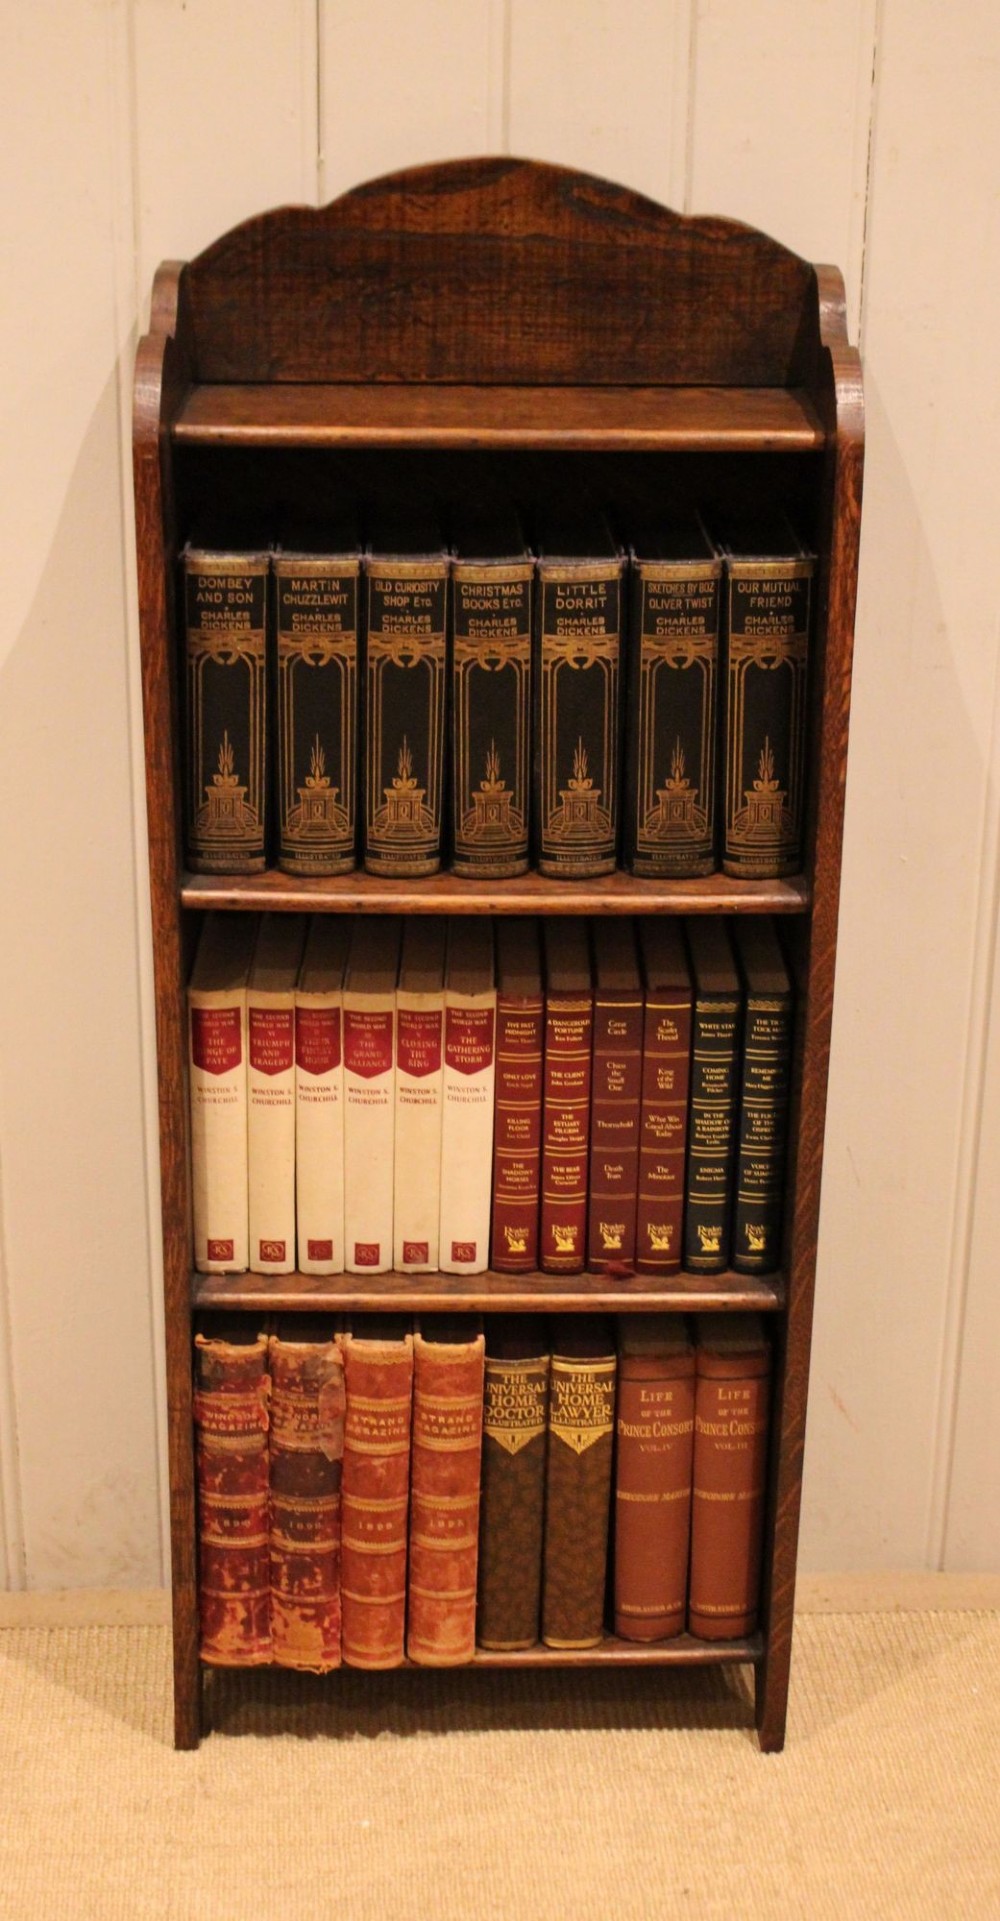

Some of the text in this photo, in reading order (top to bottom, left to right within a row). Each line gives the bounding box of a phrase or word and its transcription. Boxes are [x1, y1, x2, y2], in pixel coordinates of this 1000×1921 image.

[198, 576, 253, 589] DOMBEY
[291, 579, 340, 592] MARTIN
[375, 580, 440, 593] OLD CURIOSITY
[647, 580, 715, 594] SKETCHES BY BOZ
[737, 581, 801, 594] OUR MUTUAL
[461, 583, 524, 597] CHRISTMAS
[556, 582, 607, 596] LITTLE
[197, 592, 254, 604] AND SON
[283, 592, 349, 605] CHUZZLEWIT
[383, 594, 410, 608] SHOP
[555, 596, 608, 610] DORRIT
[749, 595, 793, 608] FRIEND
[462, 597, 500, 610] BOOKS
[648, 597, 713, 610] OLIVER TWIST
[201, 611, 250, 621] CHARLES
[292, 612, 341, 623] CHARLES
[382, 614, 431, 625] CHARLES
[556, 616, 605, 626] CHARLES
[656, 616, 706, 626] CHARLES
[744, 615, 795, 626] CHARLES
[201, 621, 251, 631] DICKENS
[468, 617, 518, 627] CHARLES
[292, 622, 342, 633] DICKENS
[382, 624, 432, 634] DICKENS
[468, 627, 518, 637] DICKENS
[556, 625, 606, 636] DICKENS
[656, 625, 706, 636] DICKENS
[744, 625, 796, 636] DICKENS
[662, 1019, 675, 1027] The
[252, 1039, 291, 1048] TRIUMPH
[359, 1040, 376, 1048] THE
[400, 1039, 438, 1048] CLOSING
[460, 1036, 477, 1045] THE
[261, 1049, 280, 1057] AND
[353, 1049, 383, 1058] GRAND
[410, 1049, 427, 1059] THE
[447, 1044, 491, 1054] GATHERING
[206, 1057, 228, 1065] FATE
[253, 1058, 290, 1067] TRAGEDY
[347, 1059, 388, 1068] ALLIANCE
[454, 1055, 483, 1064] STORM
[197, 1085, 231, 1094] WINSTON
[252, 1087, 285, 1097] WINSTON
[299, 1084, 332, 1093] WINSTON
[348, 1086, 381, 1096] WINSTON
[399, 1086, 431, 1095] WINSTON
[447, 1085, 481, 1094] WINSTON
[197, 1095, 238, 1105] CHURCHILL
[252, 1098, 293, 1106] CHURCHILL
[299, 1094, 338, 1103] CHURCHILL
[348, 1096, 388, 1105] CHURCHILL
[399, 1096, 438, 1105] CHURCHILL
[447, 1095, 487, 1104] CHURCHILL
[656, 1165, 669, 1174] The
[502, 1374, 528, 1384] THE
[571, 1373, 596, 1383] THE
[640, 1389, 673, 1403] LIFE
[718, 1387, 751, 1401] LIFE
[491, 1394, 538, 1408] HOME
[558, 1393, 605, 1406] HOME
[484, 1405, 545, 1420] DOCTOR
[550, 1402, 613, 1419] LAWYER
[352, 1414, 405, 1426] STRAND
[421, 1412, 473, 1424] STRAND
[550, 1415, 609, 1426] ILLUSTRATED
[418, 1421, 477, 1435] AGAZINE
[617, 1418, 652, 1438] PRINCE
[695, 1414, 756, 1437] PRINCE CONS
